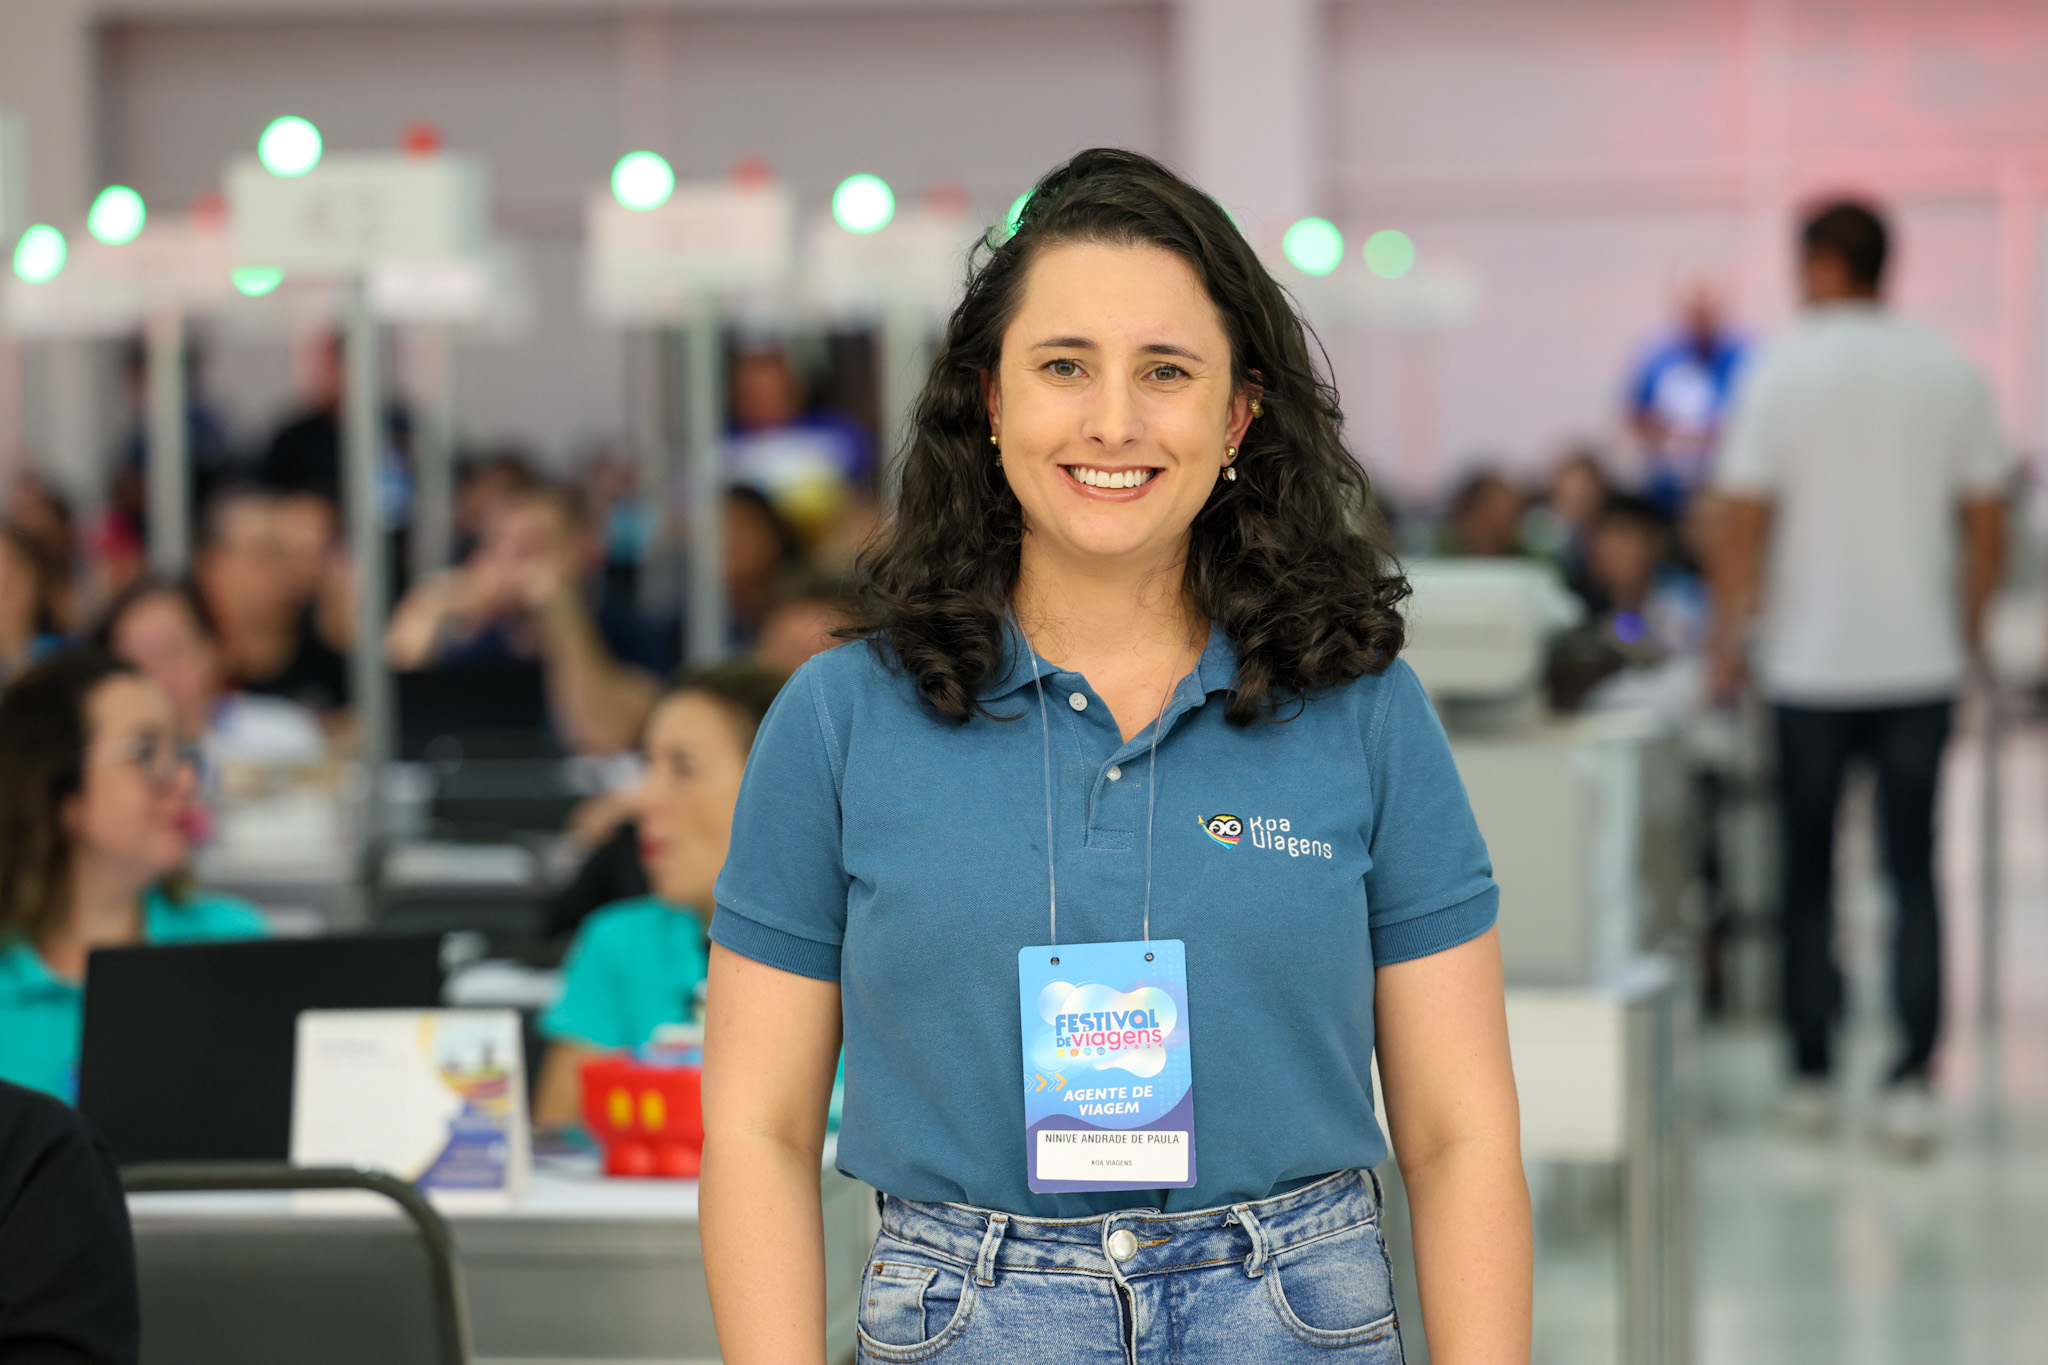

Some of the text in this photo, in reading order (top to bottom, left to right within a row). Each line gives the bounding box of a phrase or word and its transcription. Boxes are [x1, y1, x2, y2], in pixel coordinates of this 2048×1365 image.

[1249, 815, 1291, 832] Koa
[1056, 1036, 1072, 1048] DE
[1063, 1085, 1154, 1102] AGENTE DE
[1078, 1102, 1140, 1116] VIAGEM
[1081, 1133, 1128, 1144] ANDRADE
[1131, 1134, 1144, 1144] DE
[1147, 1134, 1180, 1144] PAULA
[1091, 1159, 1133, 1167] KOA VIAGENS
